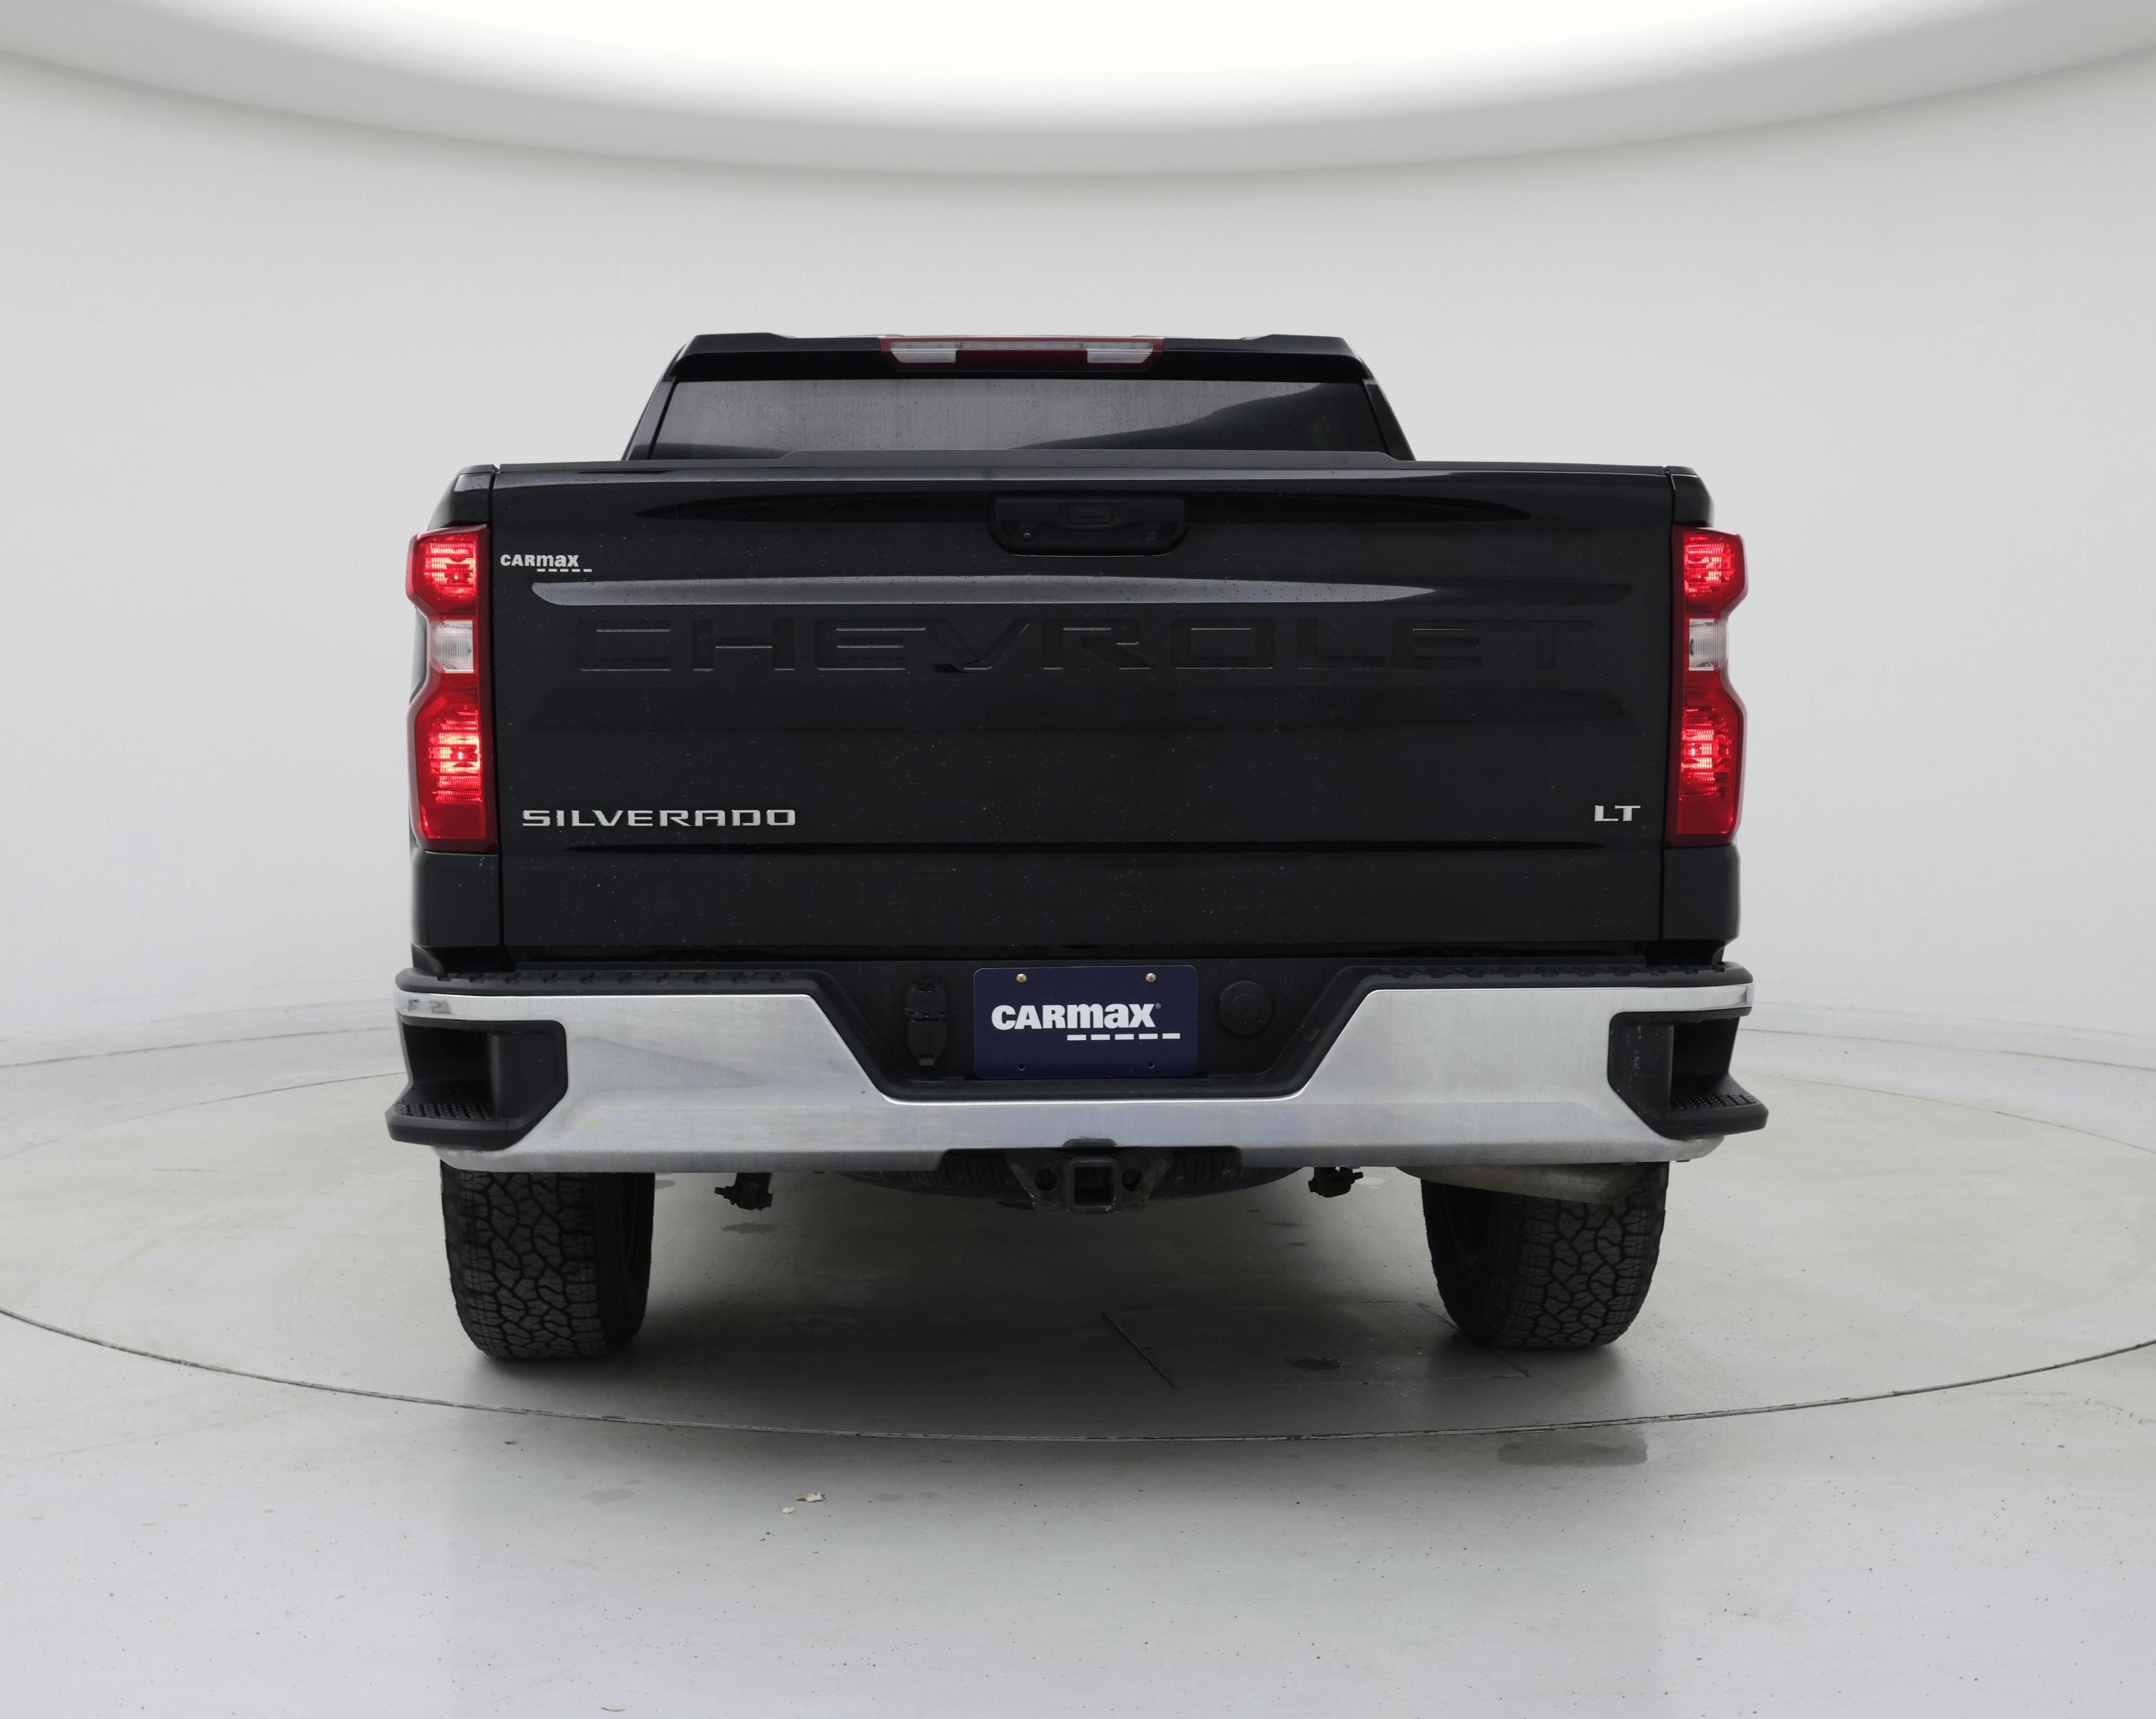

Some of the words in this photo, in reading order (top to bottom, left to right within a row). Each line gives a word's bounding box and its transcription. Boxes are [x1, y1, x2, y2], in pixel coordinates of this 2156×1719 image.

[500, 554, 579, 567] CARmax
[576, 618, 1594, 672] CHEVROLET
[522, 810, 796, 827] SILVERADO
[1594, 805, 1641, 822] LT
